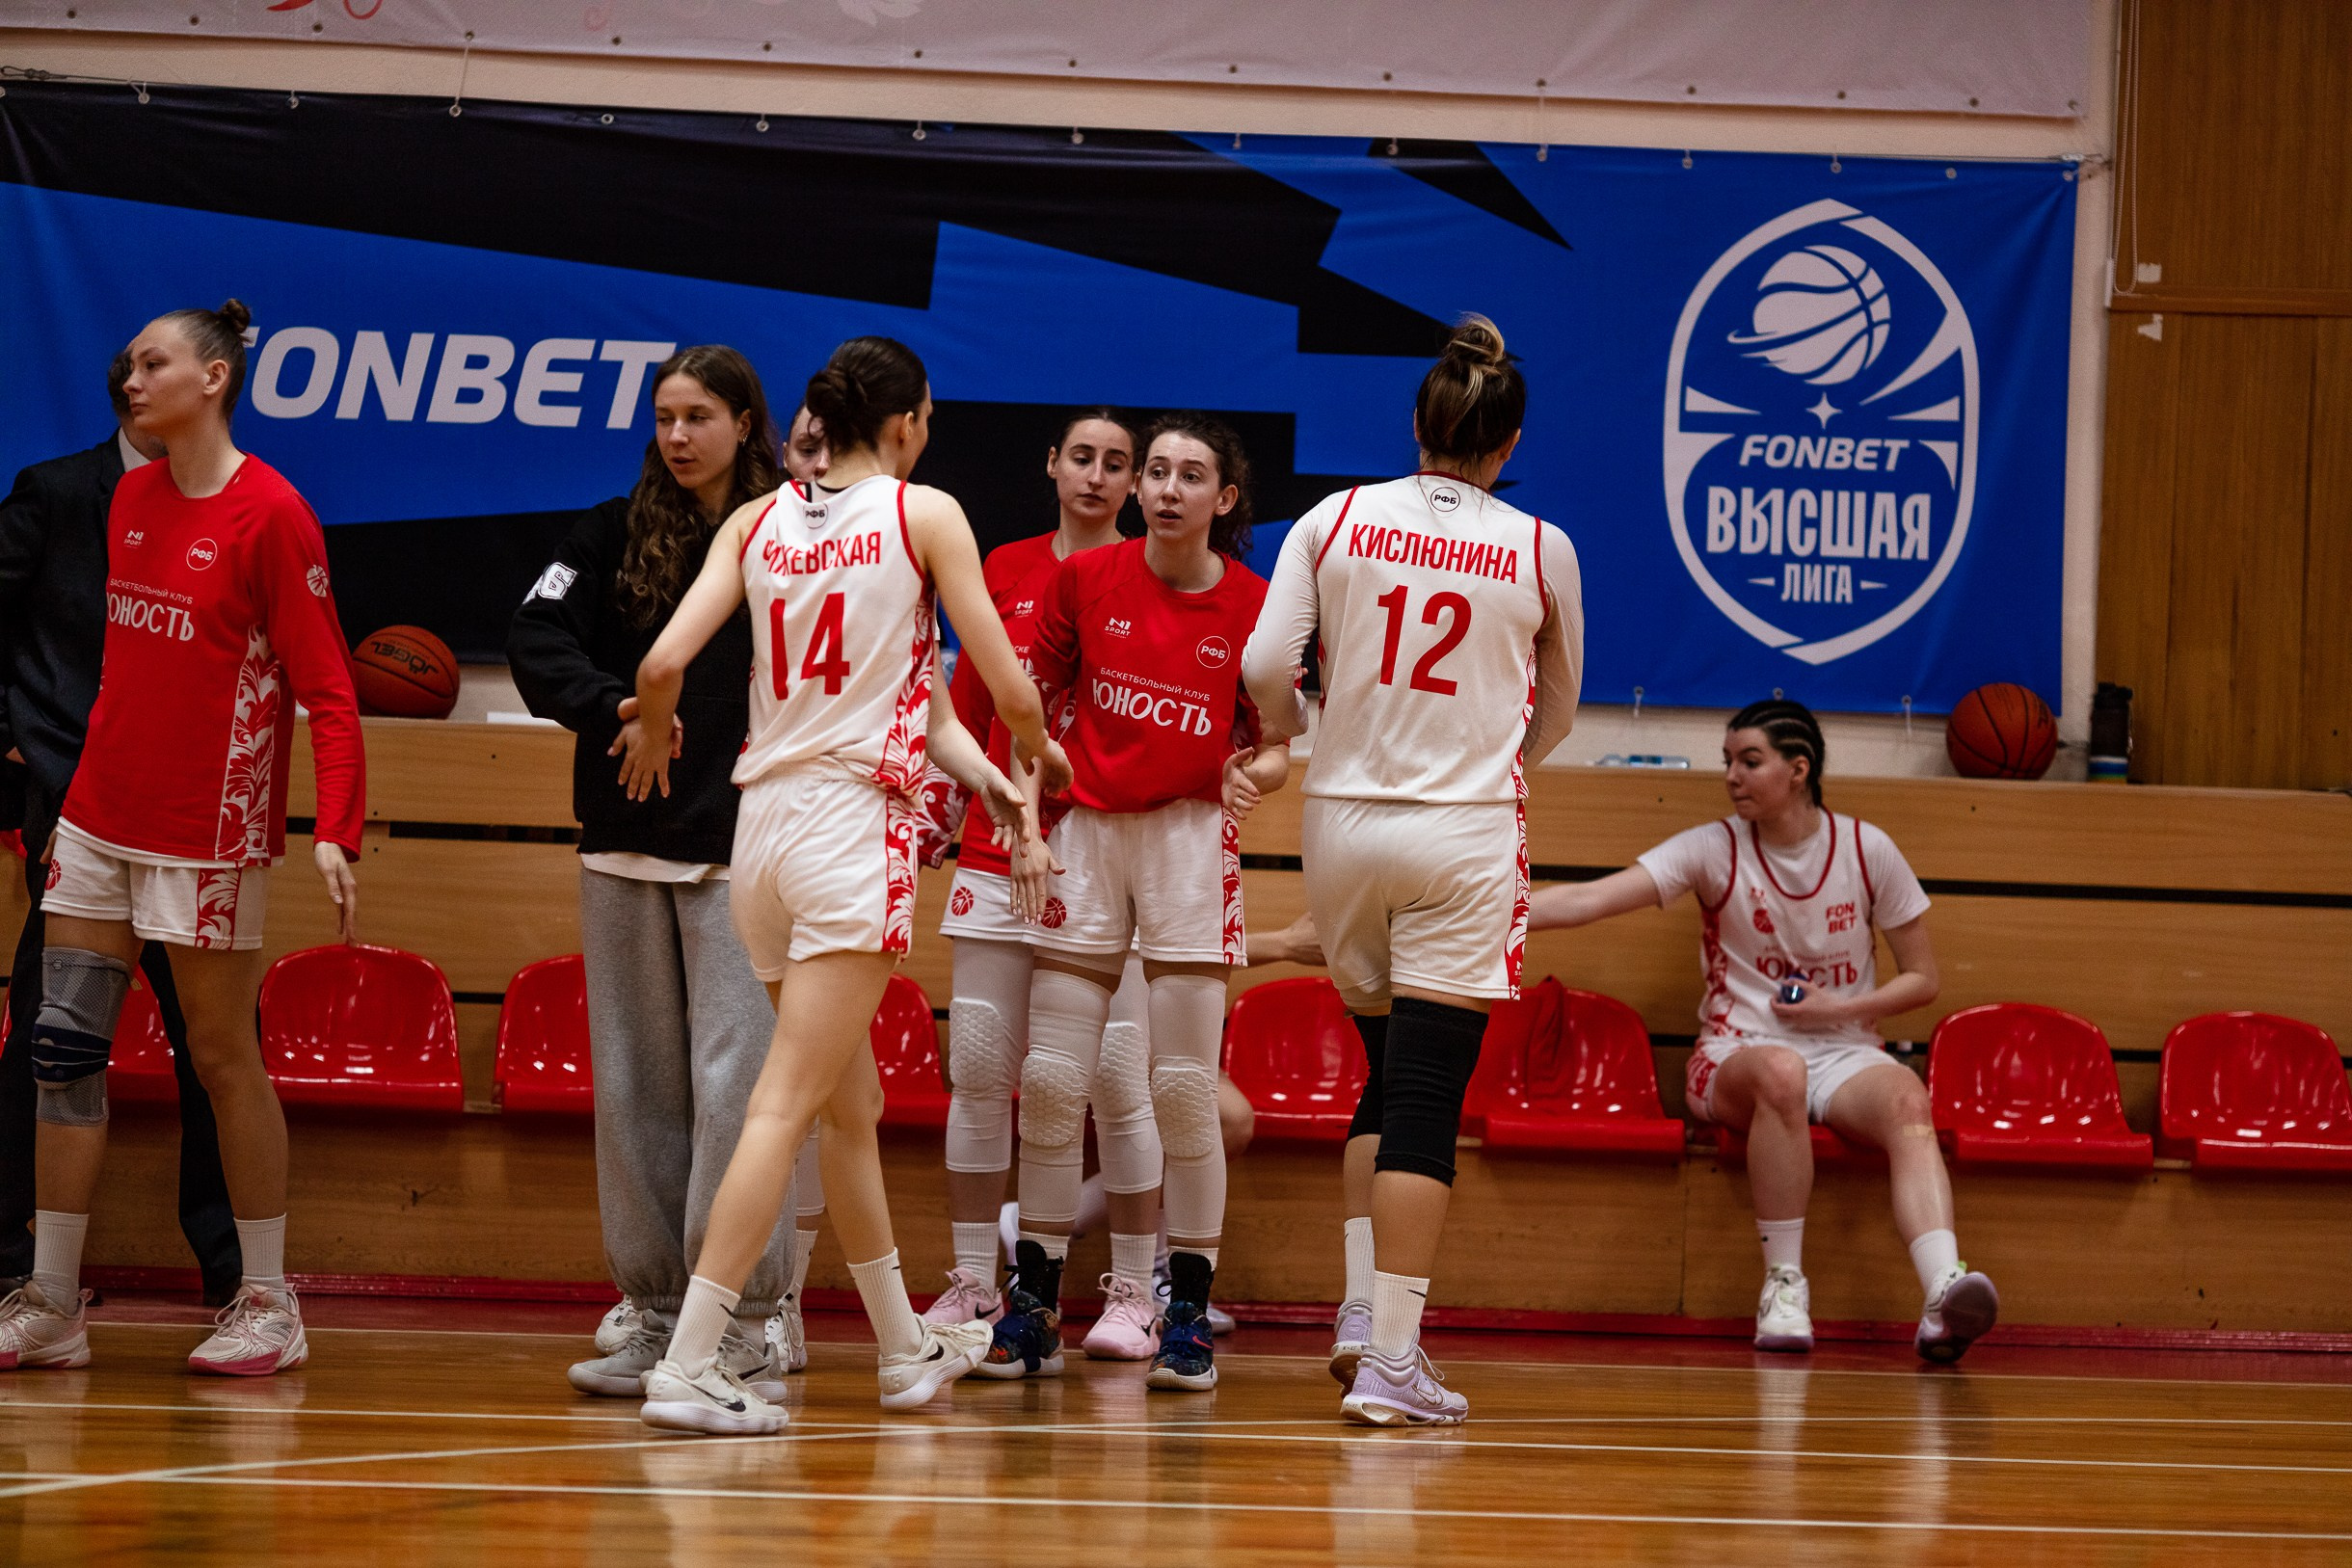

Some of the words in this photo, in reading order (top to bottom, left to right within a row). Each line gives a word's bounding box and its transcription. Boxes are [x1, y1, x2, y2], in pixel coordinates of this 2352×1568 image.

[246, 326, 677, 430] ONBET
[1739, 435, 1910, 471] FONBET
[805, 510, 825, 518] РФБ
[1433, 494, 1457, 505] РФБ
[1706, 486, 1931, 560] ВЫСШАЯ
[191, 547, 214, 561] РФБ
[762, 531, 881, 576] ЧЖЕВСКАЯ
[1348, 523, 1518, 584] КИСЛЮНИНА
[110, 578, 169, 598] БАСКЕТБОЛЬНЫЙ
[169, 592, 194, 605] КЛУБ
[1780, 563, 1853, 603] ЛИГА
[769, 592, 850, 701] 14
[1105, 625, 1131, 636] SPORT
[1376, 584, 1472, 697] 12
[1200, 646, 1226, 659] РФБ
[1100, 667, 1183, 695] БАСКЕТБОЛЬНЫЙ
[1184, 688, 1211, 702] КЛУБ
[1092, 678, 1213, 736] ЮНОСТЬ
[1826, 902, 1856, 920] FON
[1829, 917, 1857, 934] BET
